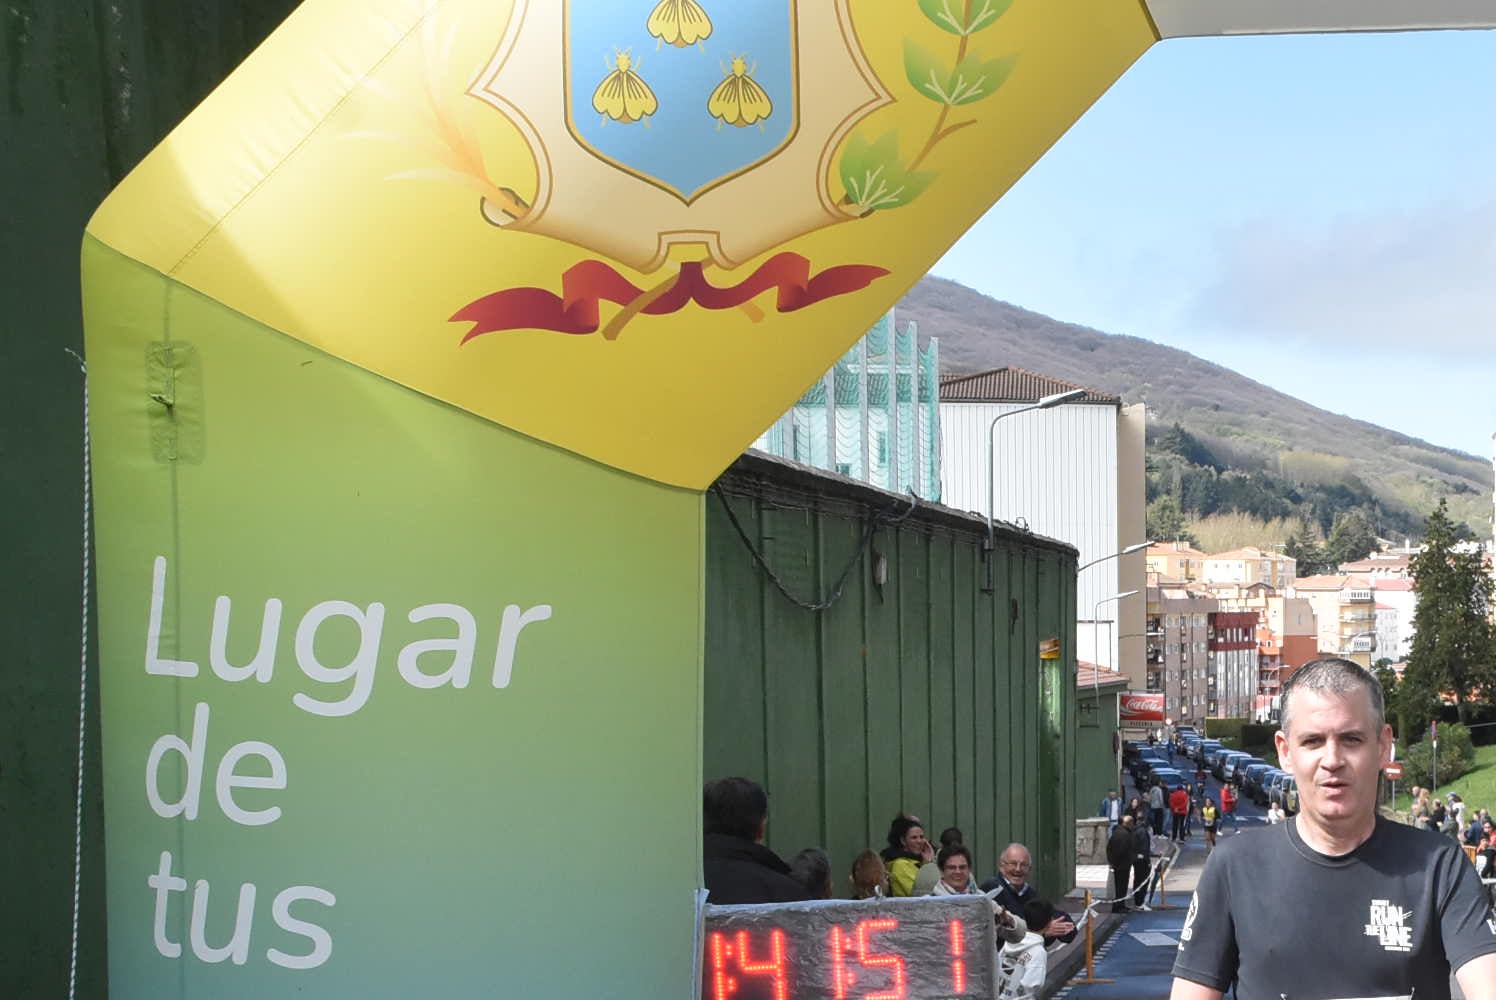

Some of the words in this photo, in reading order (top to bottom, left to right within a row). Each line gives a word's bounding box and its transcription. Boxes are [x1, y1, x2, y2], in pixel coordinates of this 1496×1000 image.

[145, 555, 552, 717] Lugar
[145, 702, 288, 826] de
[147, 851, 337, 970] tus
